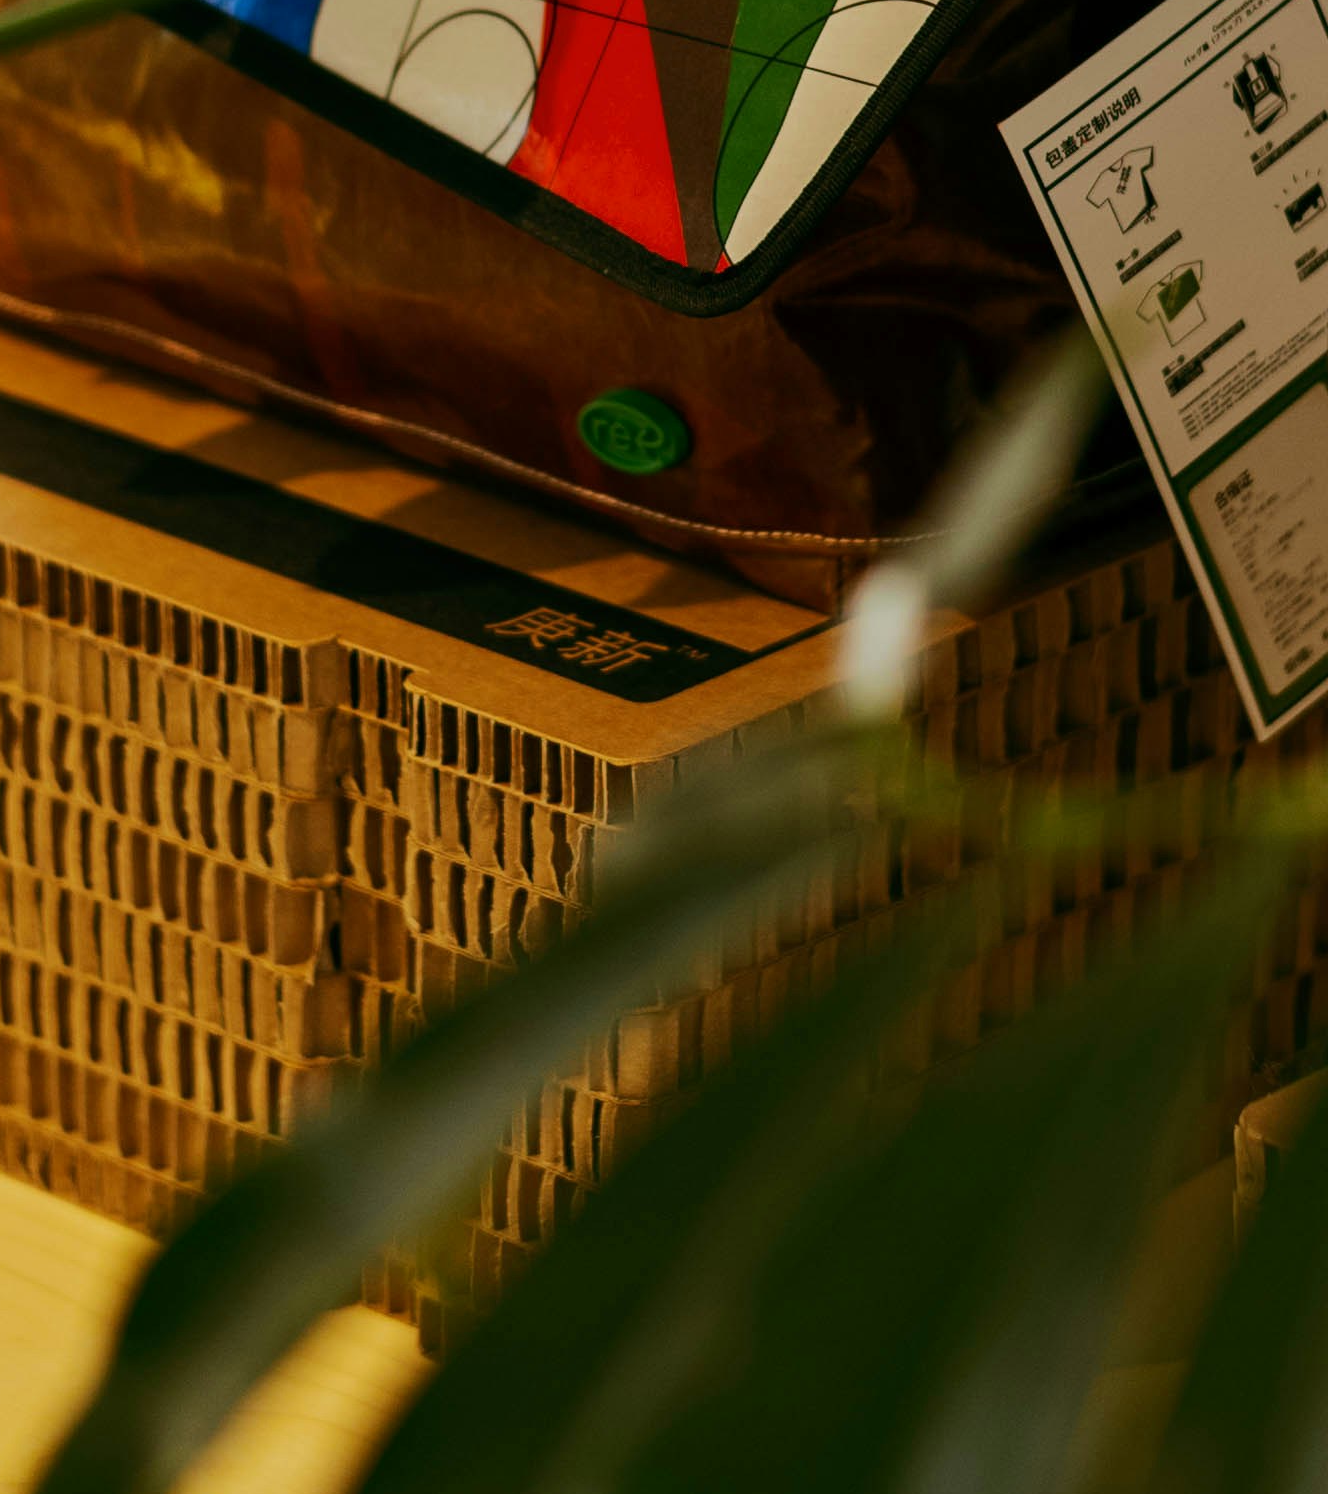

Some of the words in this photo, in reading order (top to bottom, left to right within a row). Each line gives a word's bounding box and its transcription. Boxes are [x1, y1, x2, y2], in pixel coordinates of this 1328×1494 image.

[1045, 86, 1142, 170] 包盖定制说明
